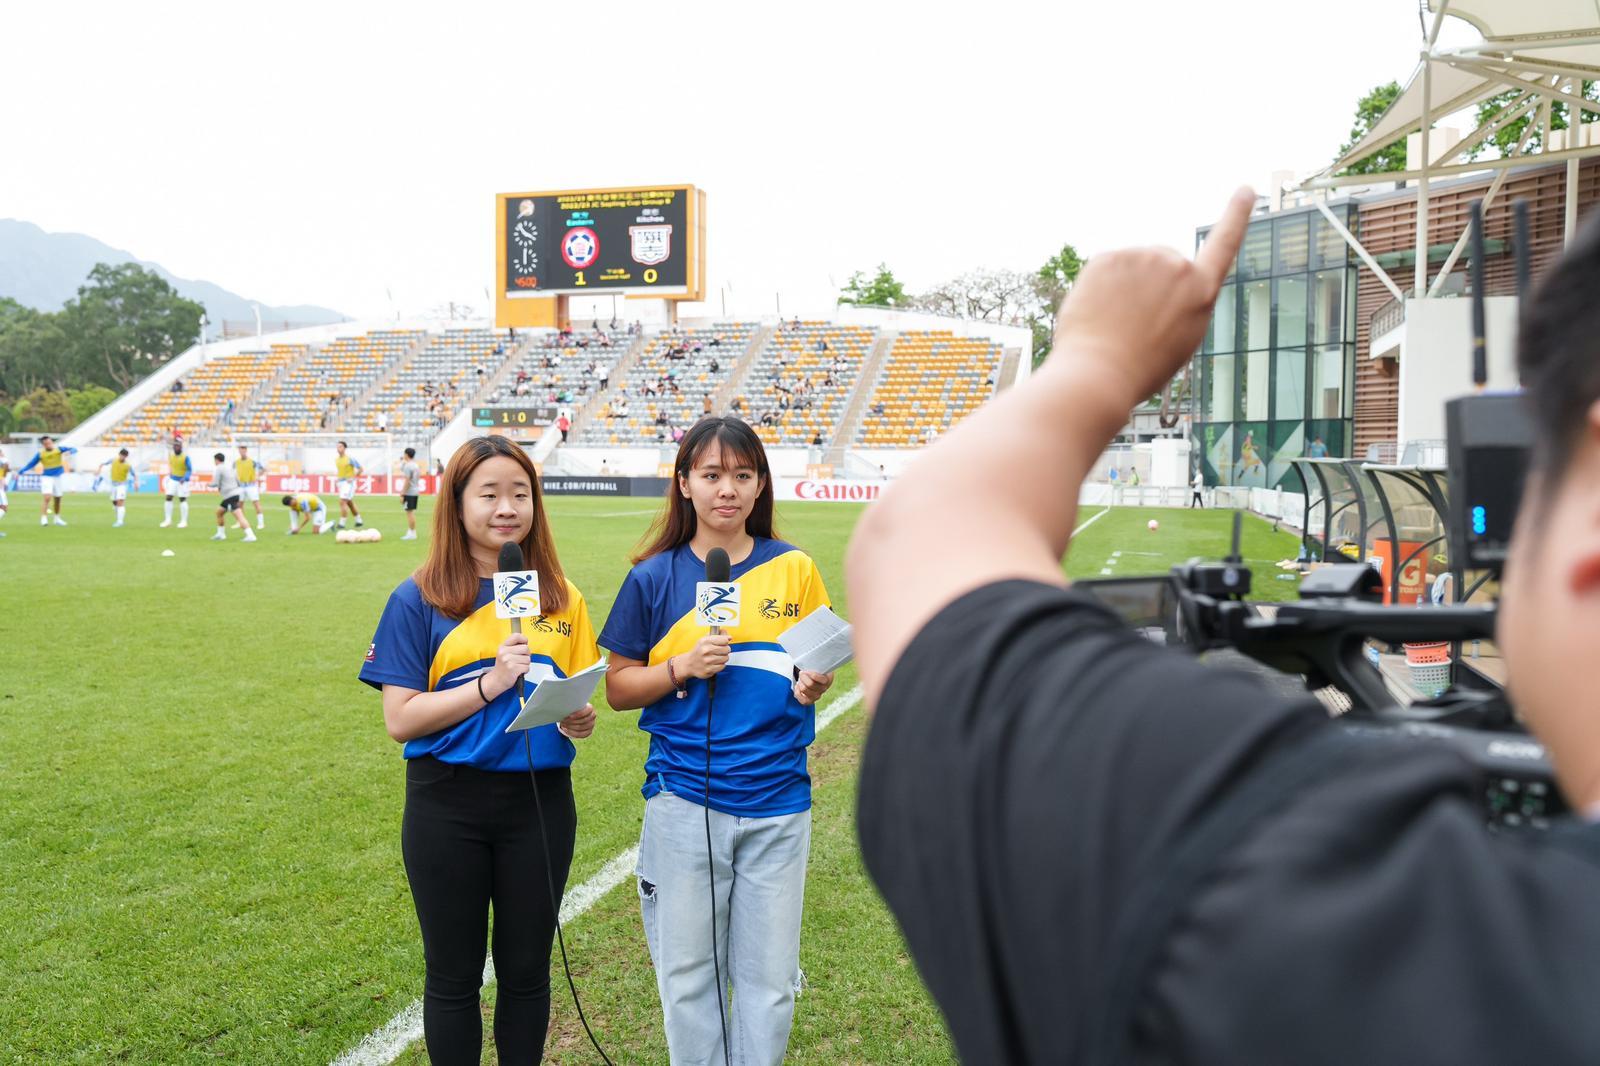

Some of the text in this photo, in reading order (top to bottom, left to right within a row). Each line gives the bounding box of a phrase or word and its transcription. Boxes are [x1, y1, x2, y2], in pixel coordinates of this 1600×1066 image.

[574, 270, 587, 286] 1
[643, 268, 658, 284] 0
[795, 481, 880, 500] Canon
